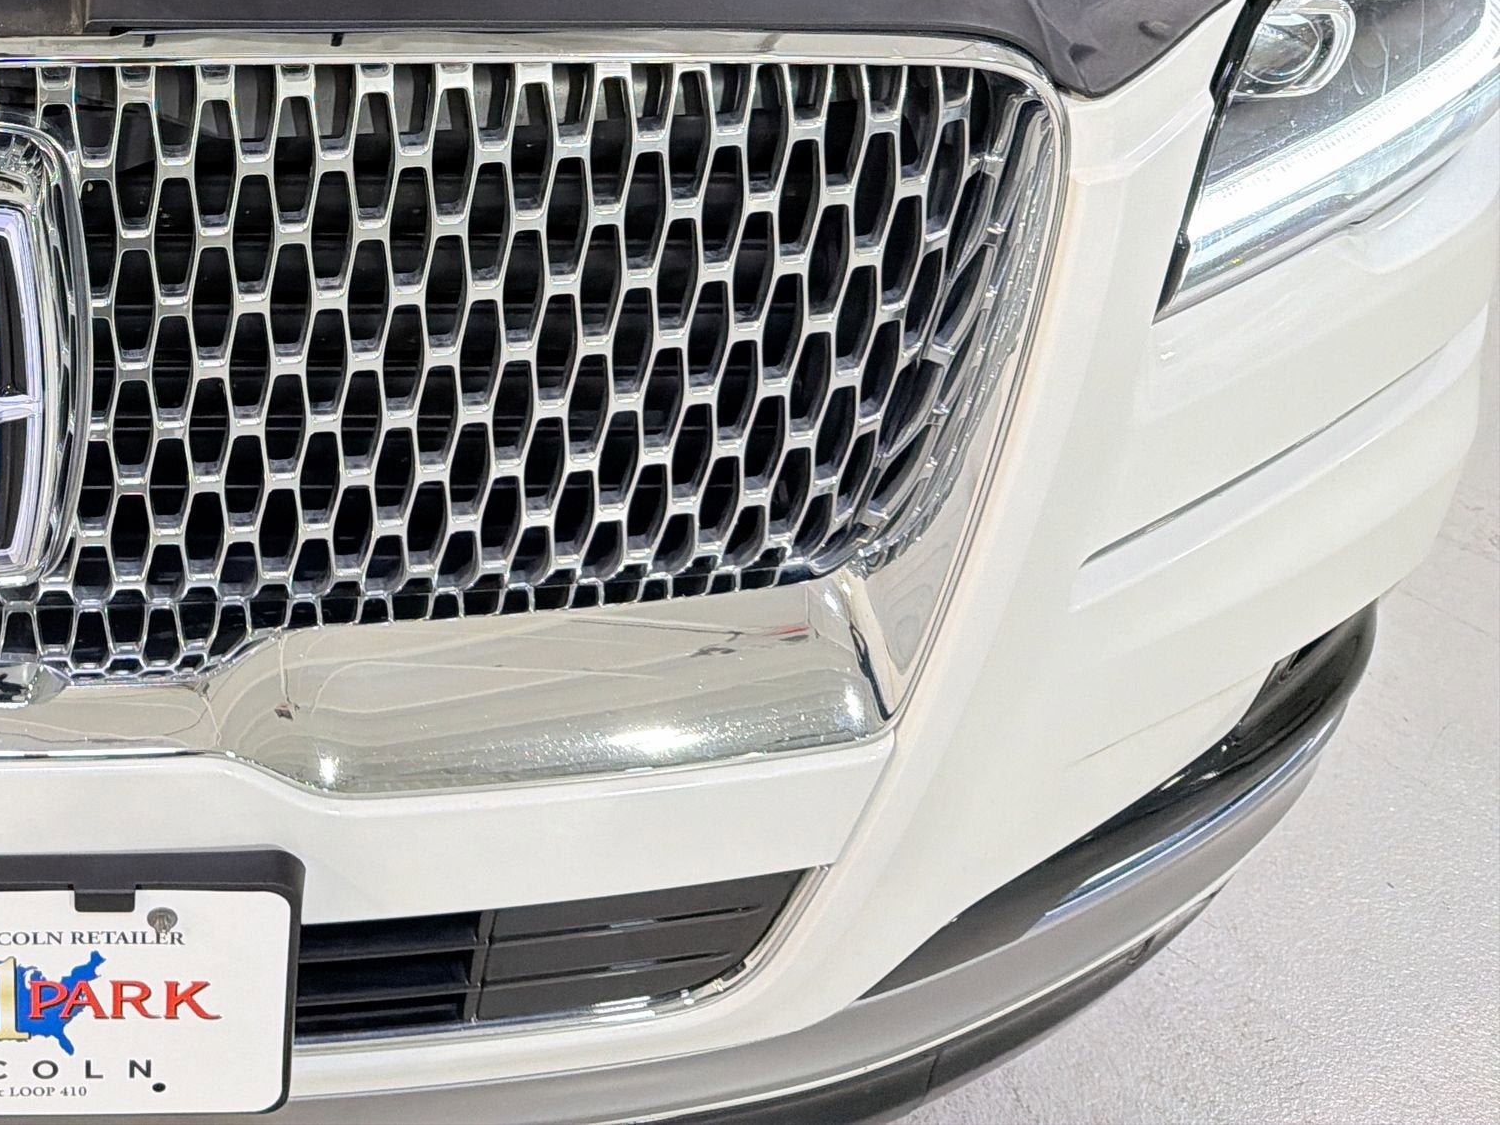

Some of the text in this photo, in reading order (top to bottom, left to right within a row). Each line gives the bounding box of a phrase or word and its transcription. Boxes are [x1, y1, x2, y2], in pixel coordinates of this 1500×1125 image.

[71, 930, 186, 946] RETAILER
[28, 979, 222, 1021] PARK
[10, 1085, 56, 1098] LOOP
[59, 1085, 87, 1097] 410
